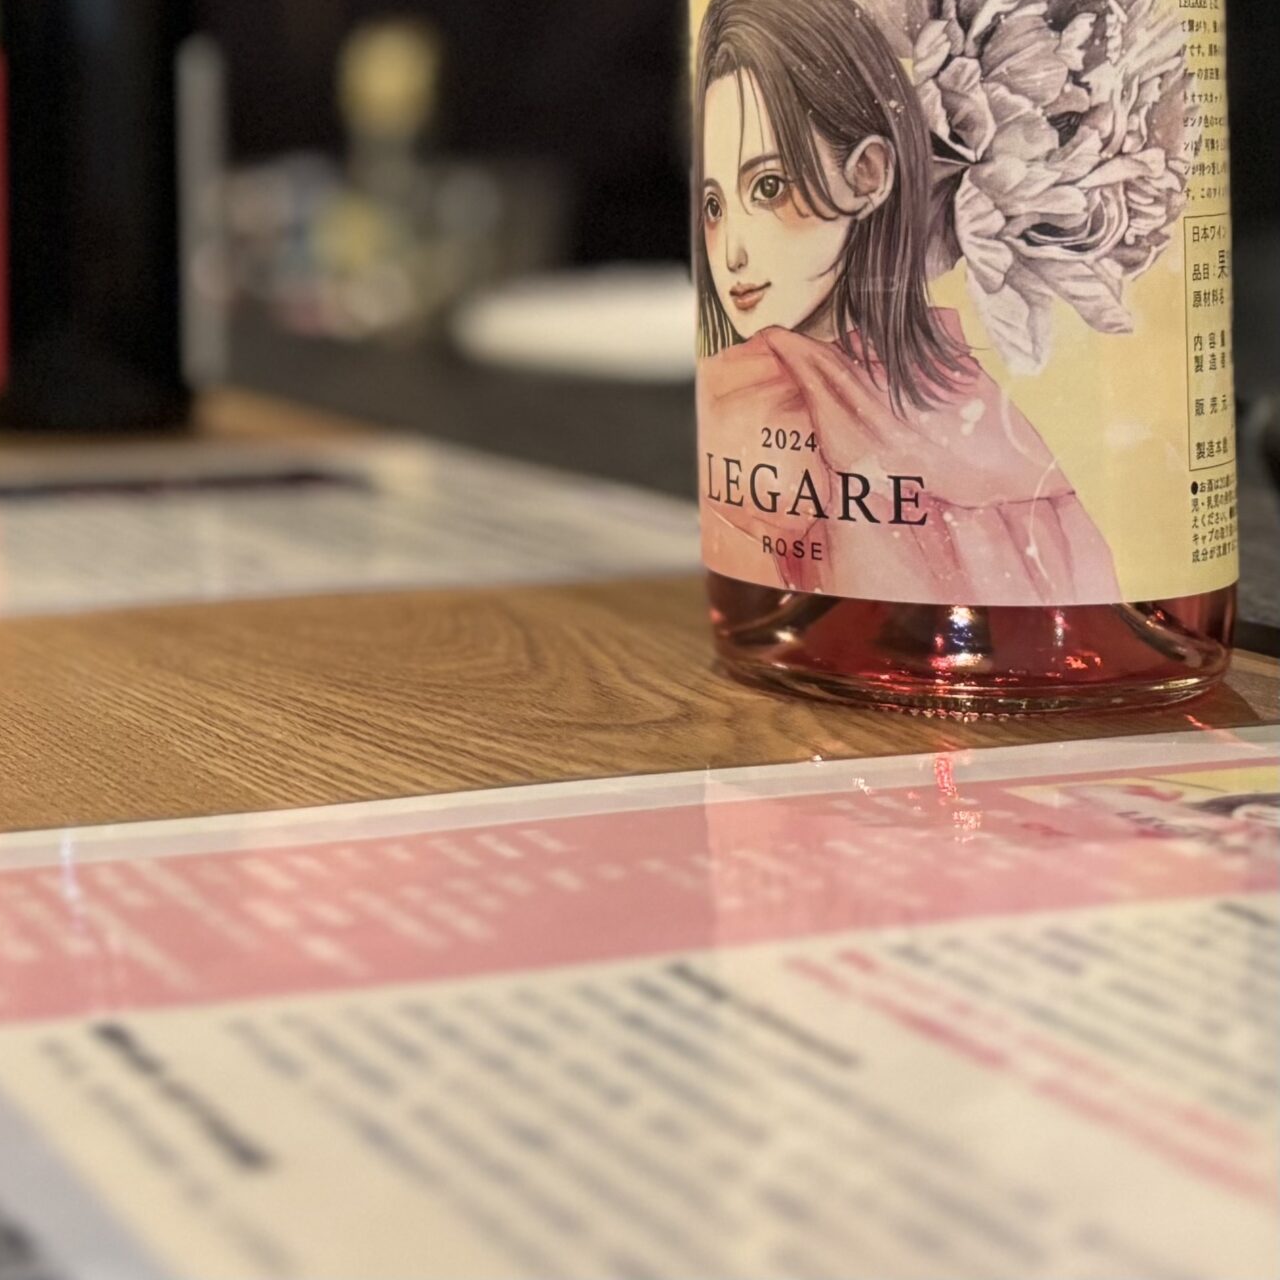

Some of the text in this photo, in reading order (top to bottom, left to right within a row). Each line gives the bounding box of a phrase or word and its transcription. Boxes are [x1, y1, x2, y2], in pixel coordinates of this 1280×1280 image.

[761, 426, 818, 452] 2024
[706, 453, 928, 526] LEGARE
[762, 535, 822, 561] ROSE
